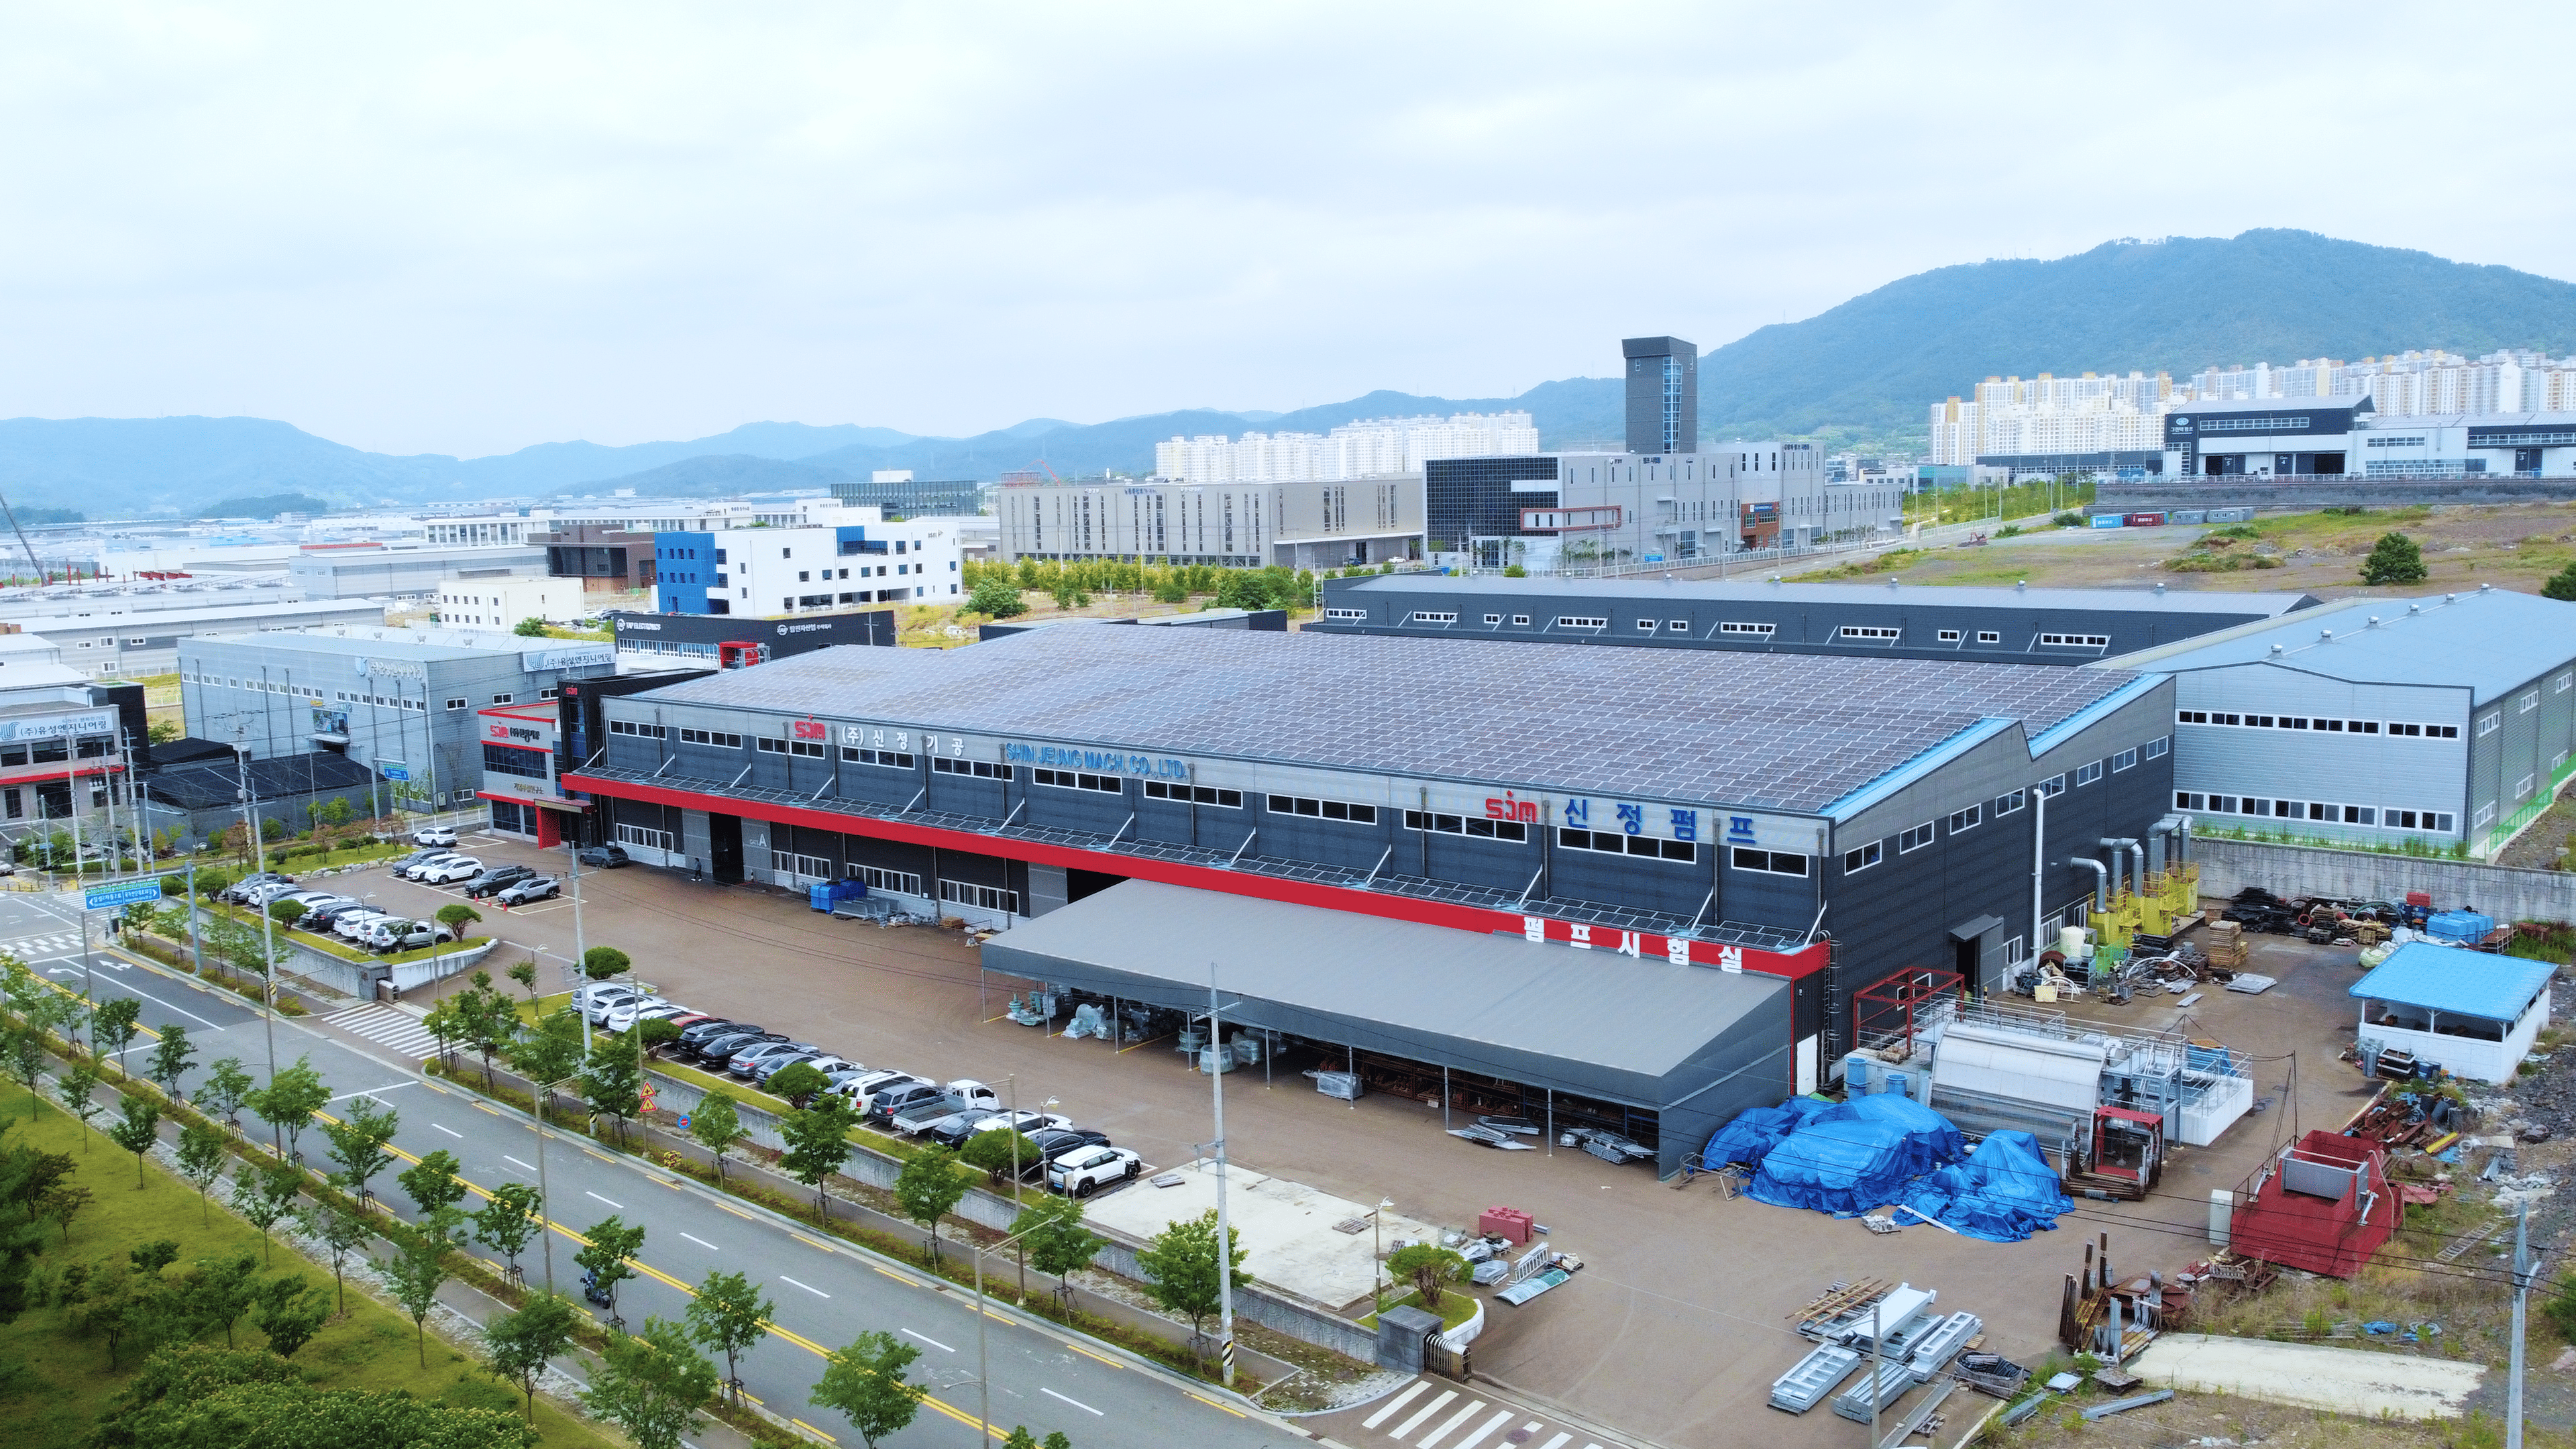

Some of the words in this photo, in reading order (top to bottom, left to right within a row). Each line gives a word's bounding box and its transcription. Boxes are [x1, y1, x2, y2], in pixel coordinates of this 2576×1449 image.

[20, 720, 107, 737] (주)유성엔지니어링
[1006, 743, 1036, 763] SHIN
[1038, 747, 1082, 767] JEUNG
[1564, 798, 1757, 844] 신정펌프
[759, 833, 767, 847] A
[1523, 916, 1743, 974] 펌프시험실
